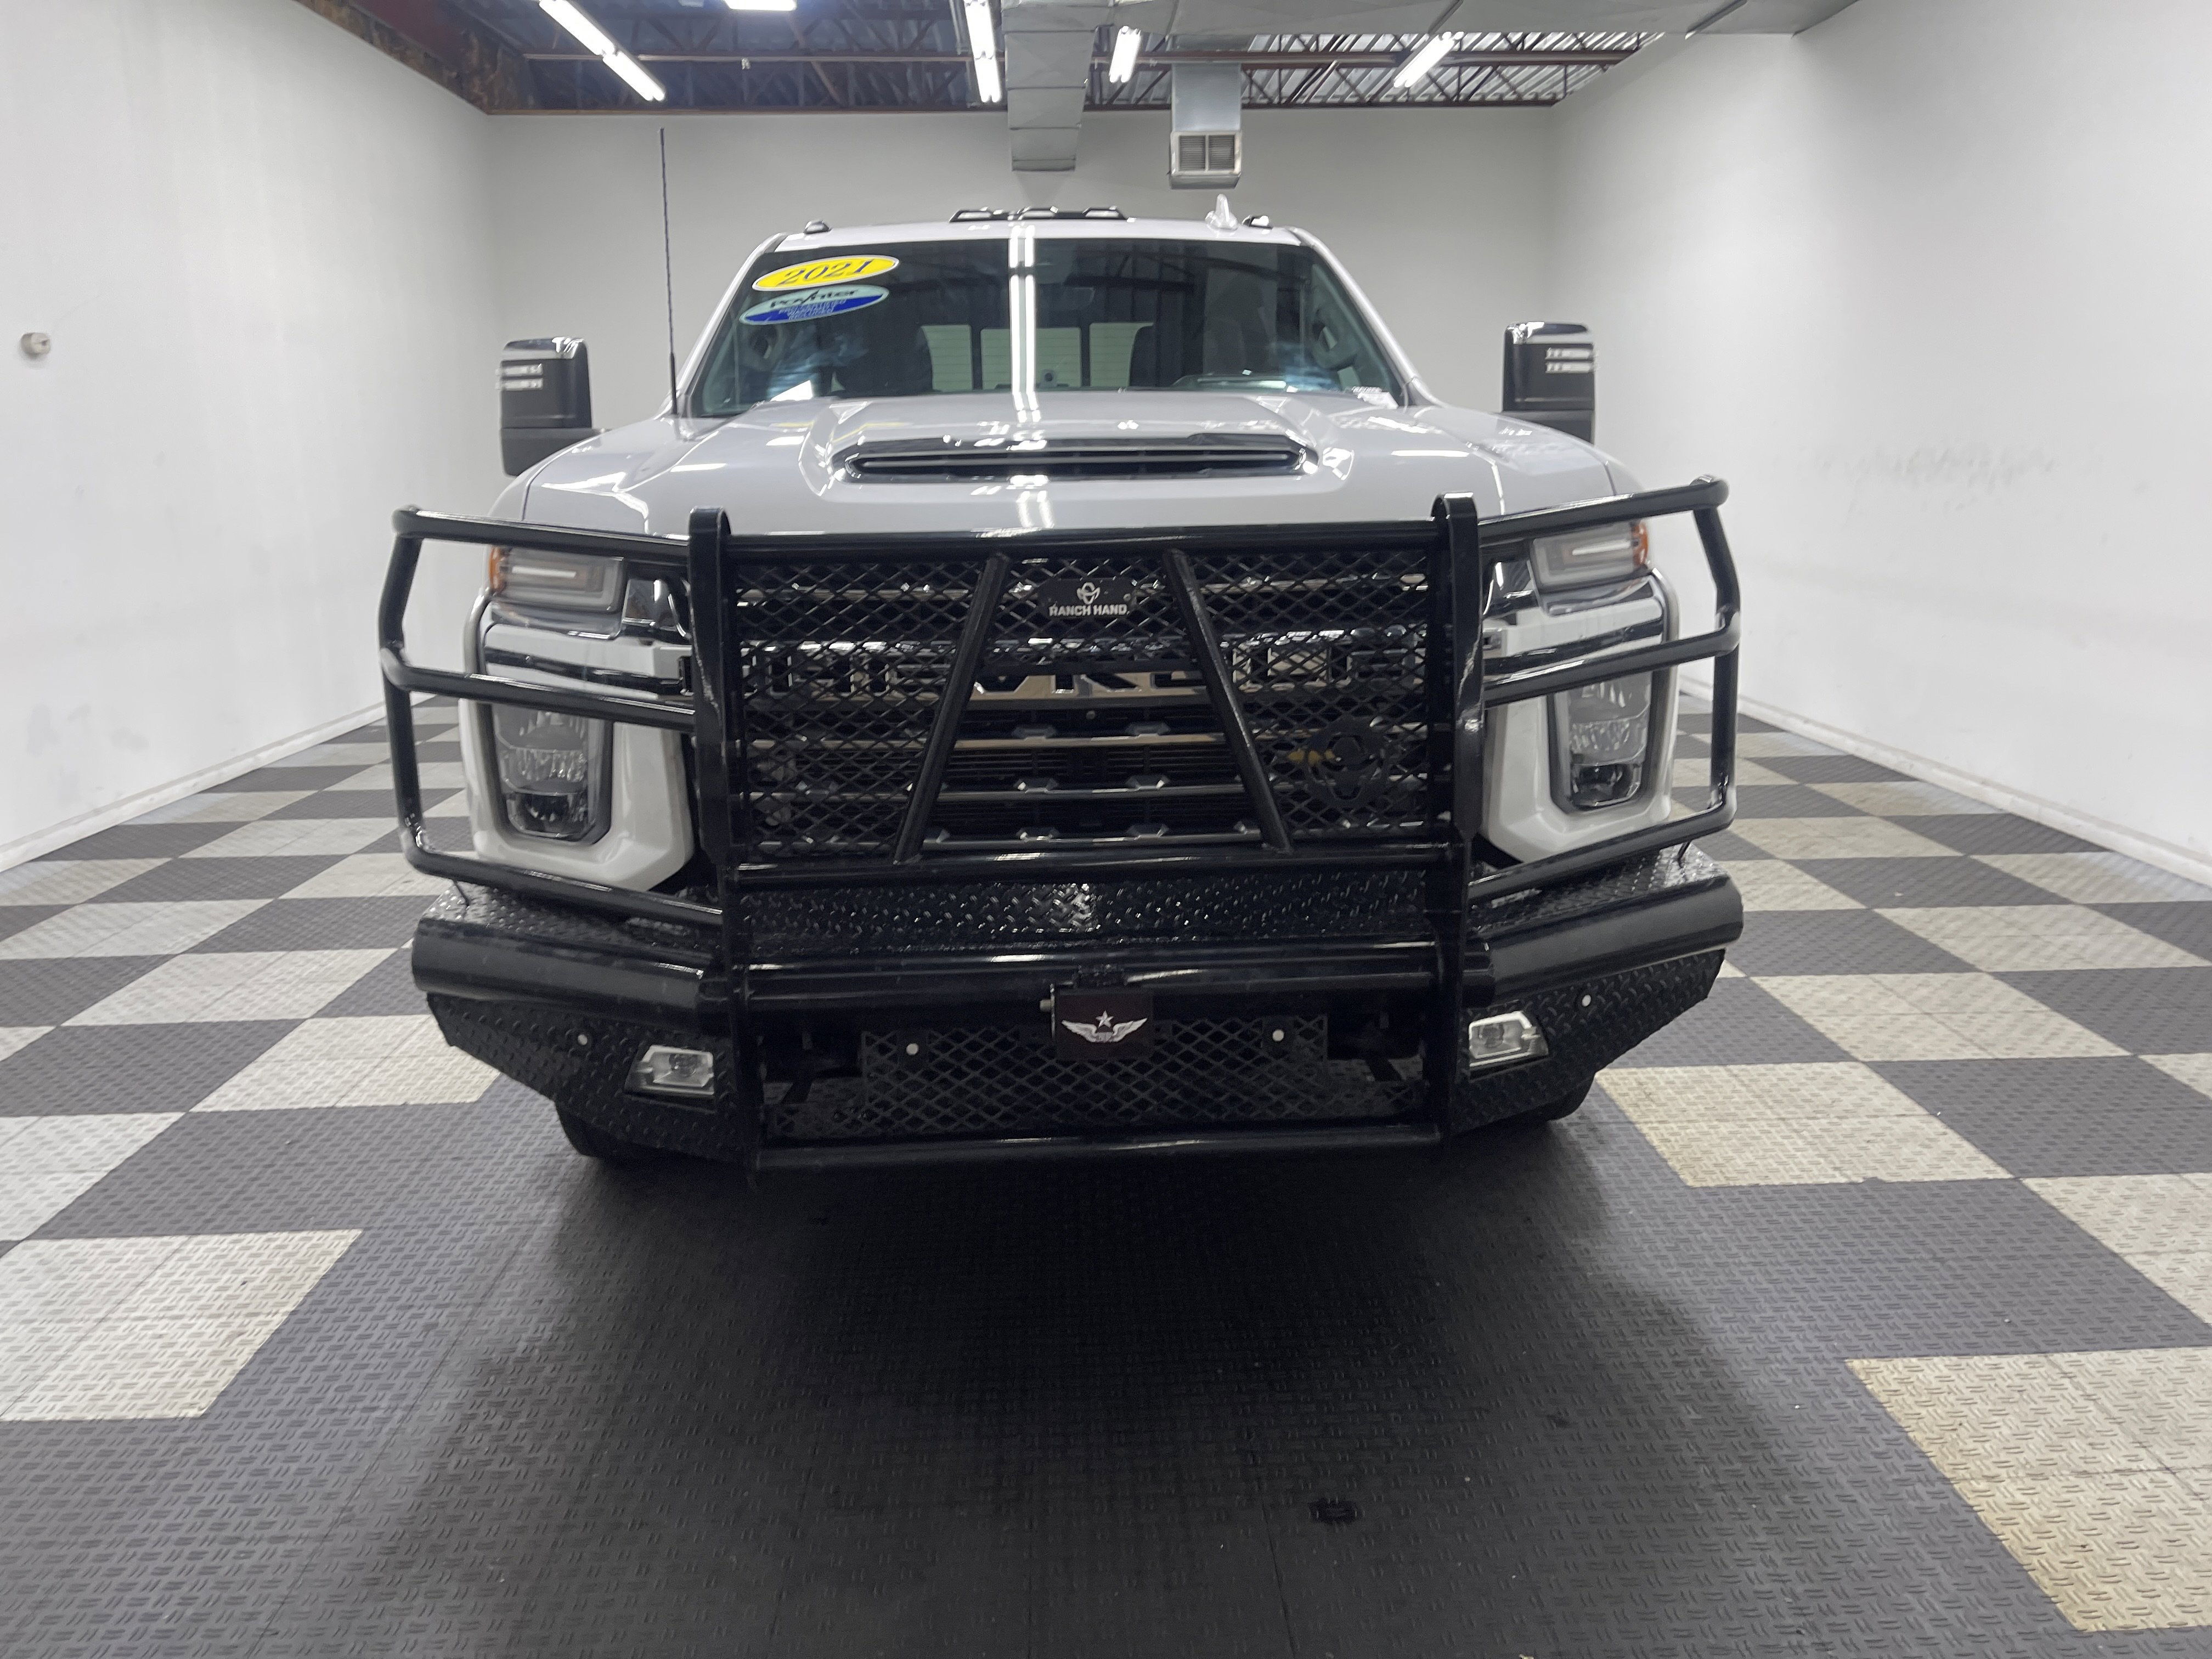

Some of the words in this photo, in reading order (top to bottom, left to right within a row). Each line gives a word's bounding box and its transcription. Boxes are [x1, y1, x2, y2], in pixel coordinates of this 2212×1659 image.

[776, 258, 874, 286] 2021
[1048, 604, 1092, 617] RANCH
[1093, 603, 1128, 616] HAND
